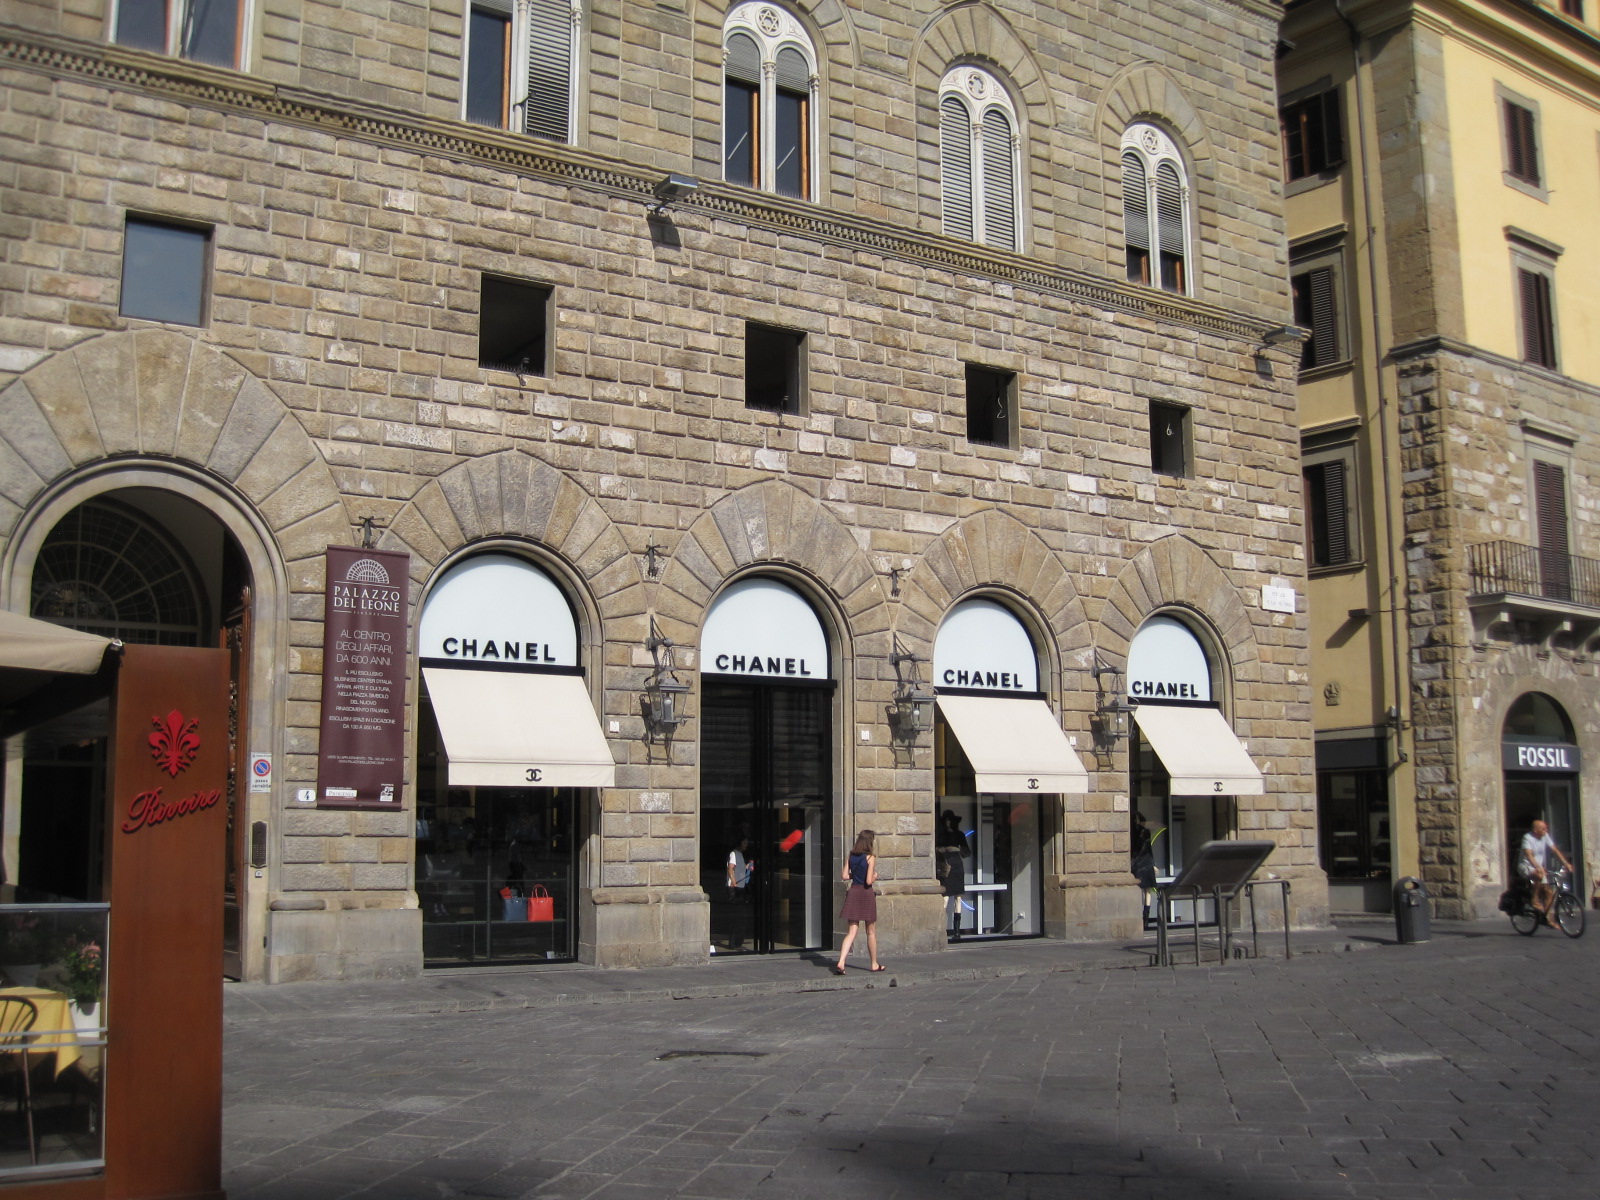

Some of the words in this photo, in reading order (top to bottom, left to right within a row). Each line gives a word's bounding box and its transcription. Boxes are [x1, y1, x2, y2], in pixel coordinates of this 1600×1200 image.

[334, 586, 400, 601] PALAZZO
[334, 597, 356, 608] DEL
[361, 600, 399, 612] LEONE
[340, 629, 352, 639] AL
[354, 630, 391, 642] CENTRO
[336, 641, 361, 652] DEGLI
[363, 643, 394, 655] AFFARI,
[442, 637, 556, 662] CHANEL
[336, 654, 349, 663] DA
[351, 654, 369, 664] 600
[715, 654, 811, 675] CHANEL
[943, 669, 1023, 688] CHANEL
[1132, 681, 1198, 698] CHANEL
[1518, 747, 1569, 768] FOSSIL
[304, 790, 310, 800] 4
[122, 786, 221, 834] Rivoire
